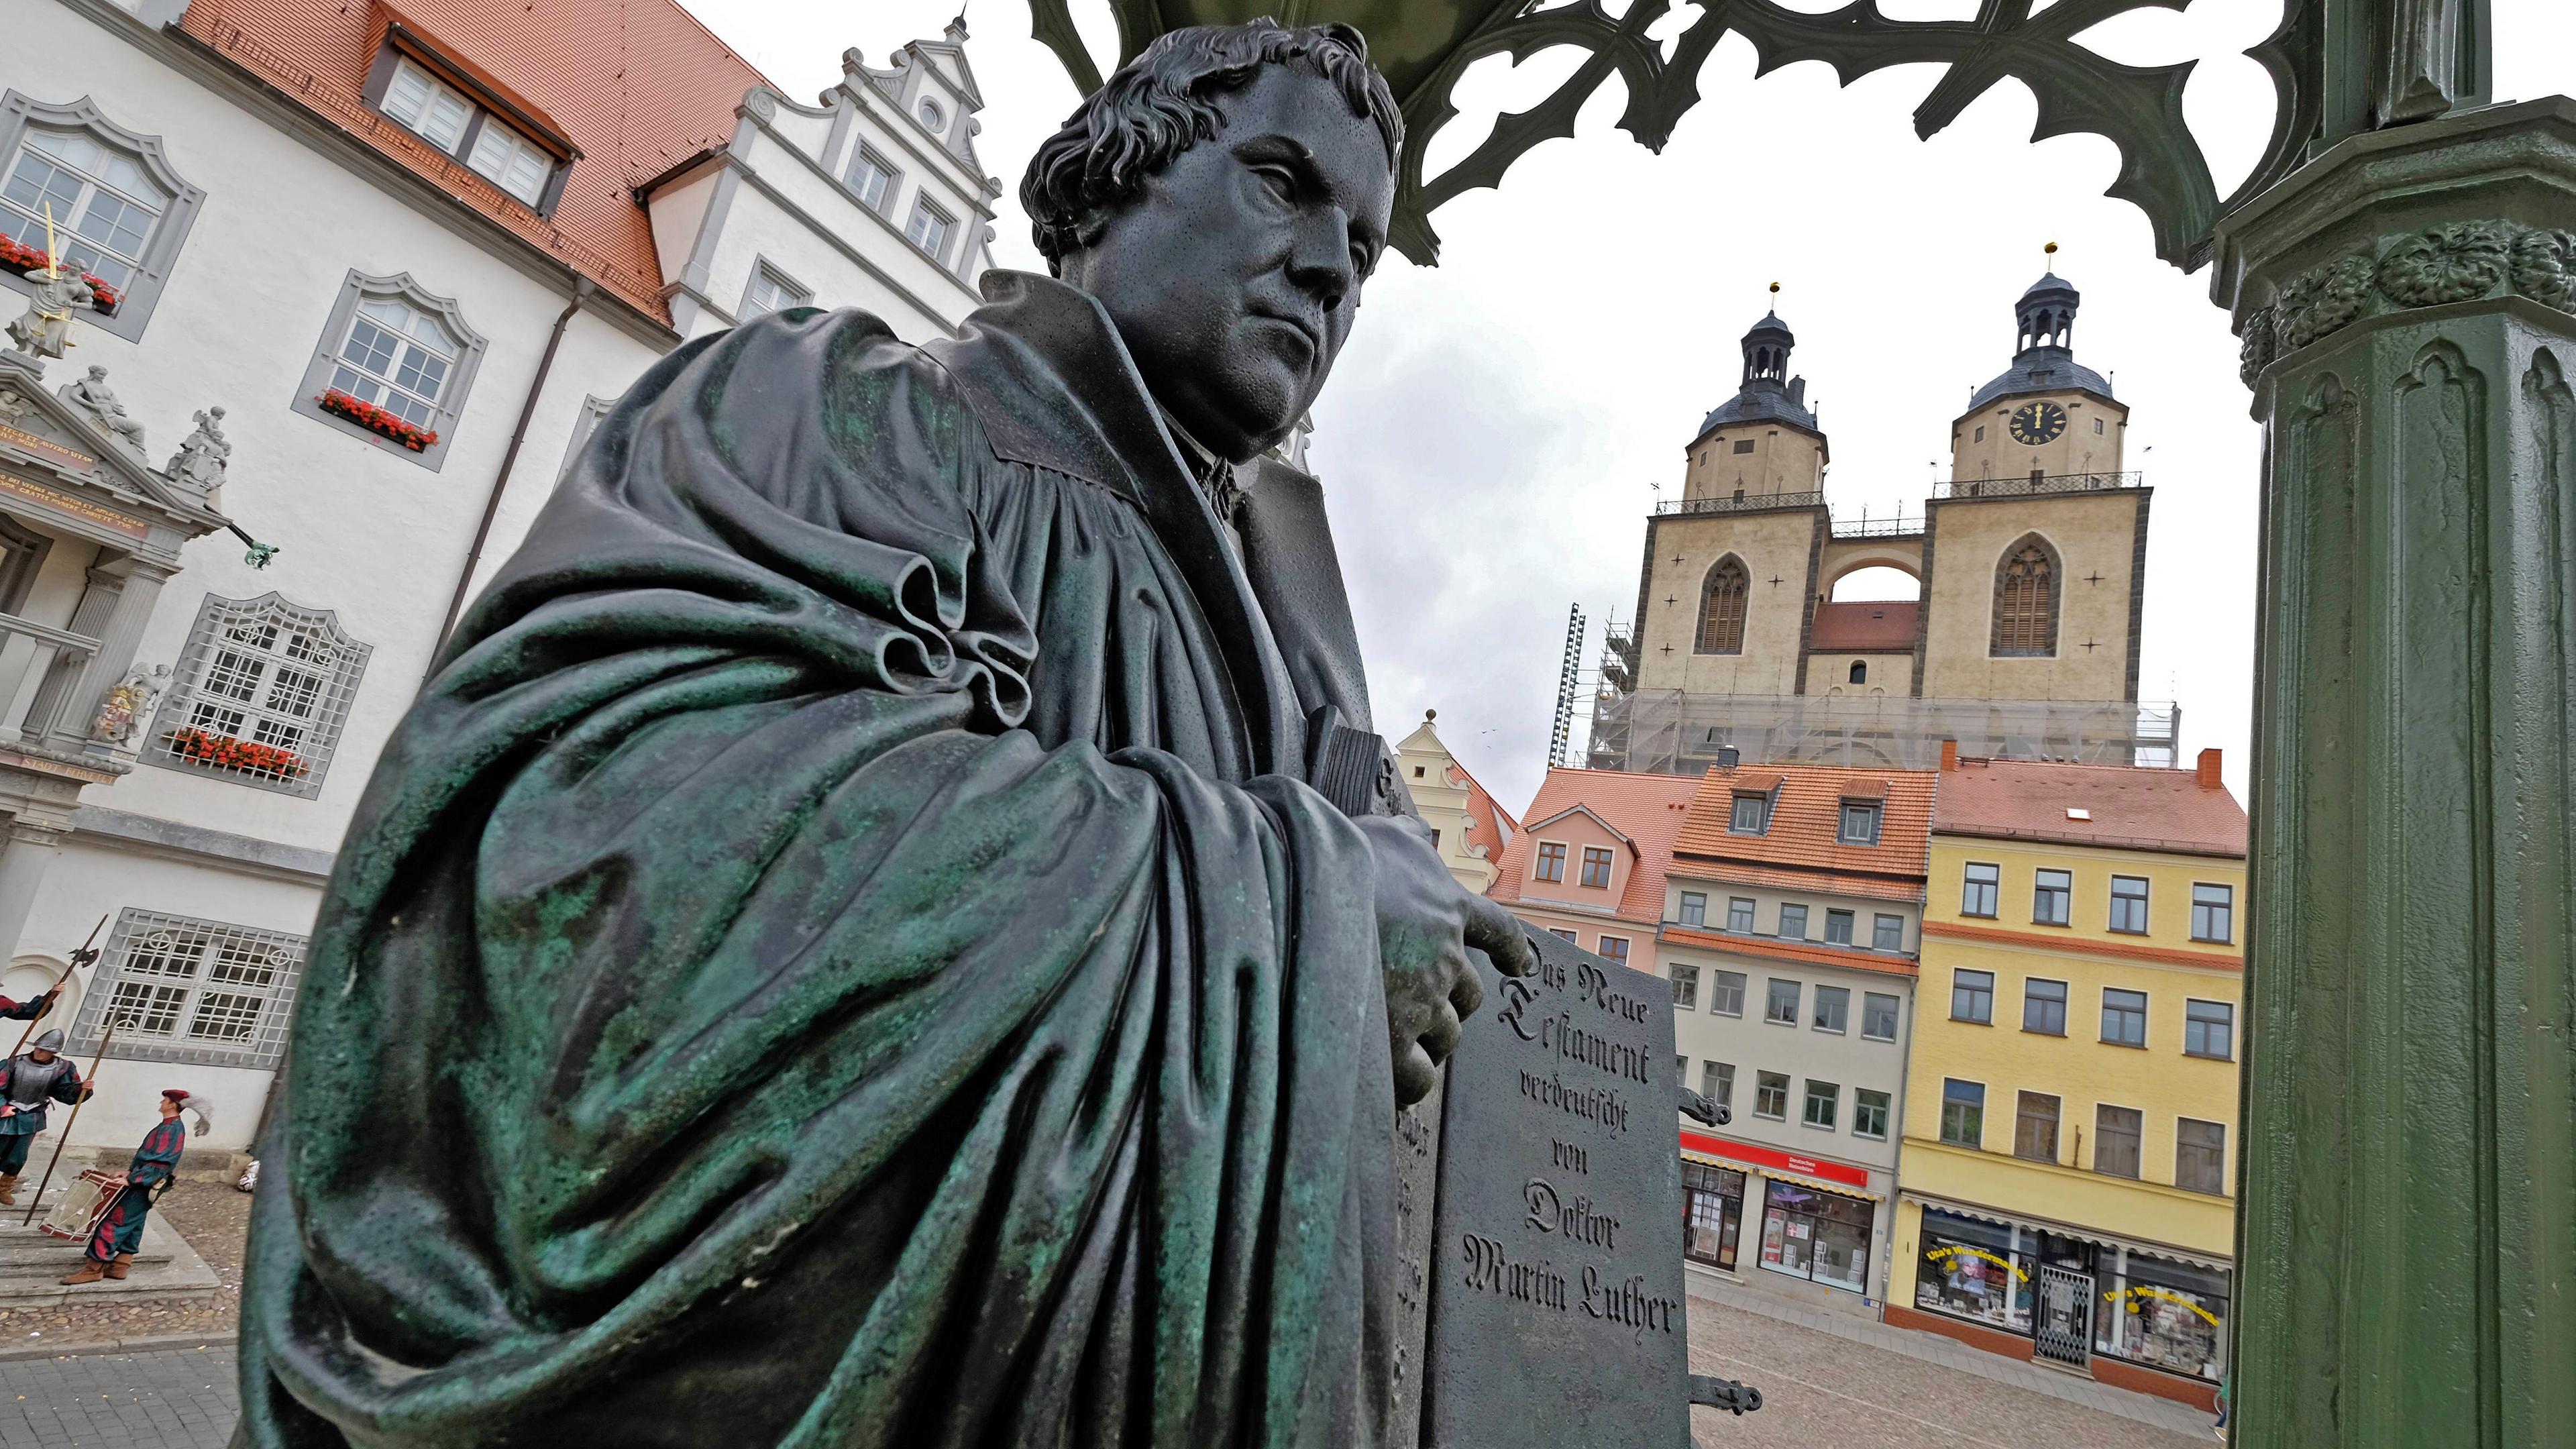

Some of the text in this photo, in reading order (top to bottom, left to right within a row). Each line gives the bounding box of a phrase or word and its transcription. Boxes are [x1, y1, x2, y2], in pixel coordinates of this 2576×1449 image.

[1578, 961, 1650, 1024] Neue
[1552, 1137, 1588, 1175] von
[1523, 1177, 1621, 1250] Doktor
[1464, 1233, 1678, 1346] Martin Luther
